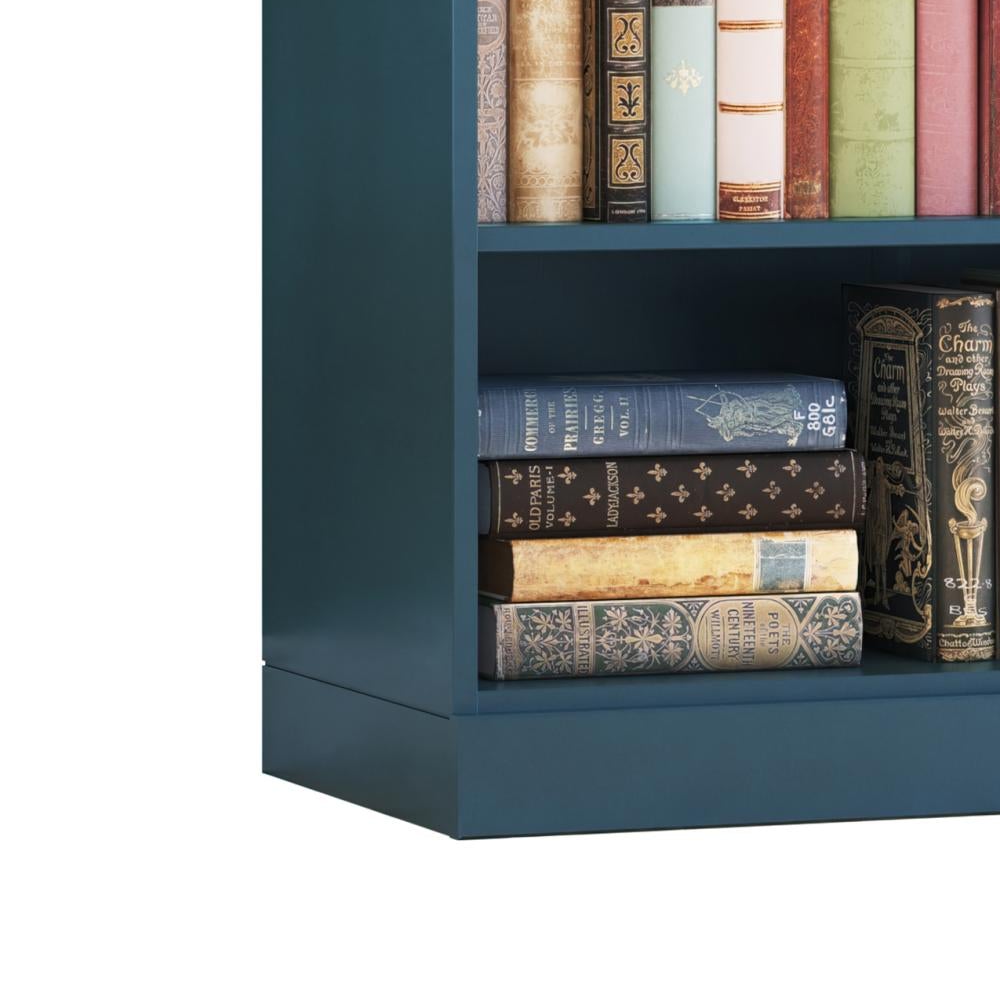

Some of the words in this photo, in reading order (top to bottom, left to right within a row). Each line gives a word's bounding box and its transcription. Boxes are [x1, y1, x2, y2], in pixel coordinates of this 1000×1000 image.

[958, 319, 978, 334] The
[938, 334, 993, 353] Charm
[950, 377, 986, 396] Plays
[547, 401, 556, 418] THE
[793, 409, 806, 420] F
[807, 402, 821, 431] 800
[548, 422, 556, 434] OF
[727, 609, 740, 661] CENTURY
[767, 612, 779, 655] POETS
[781, 622, 791, 646] THE
